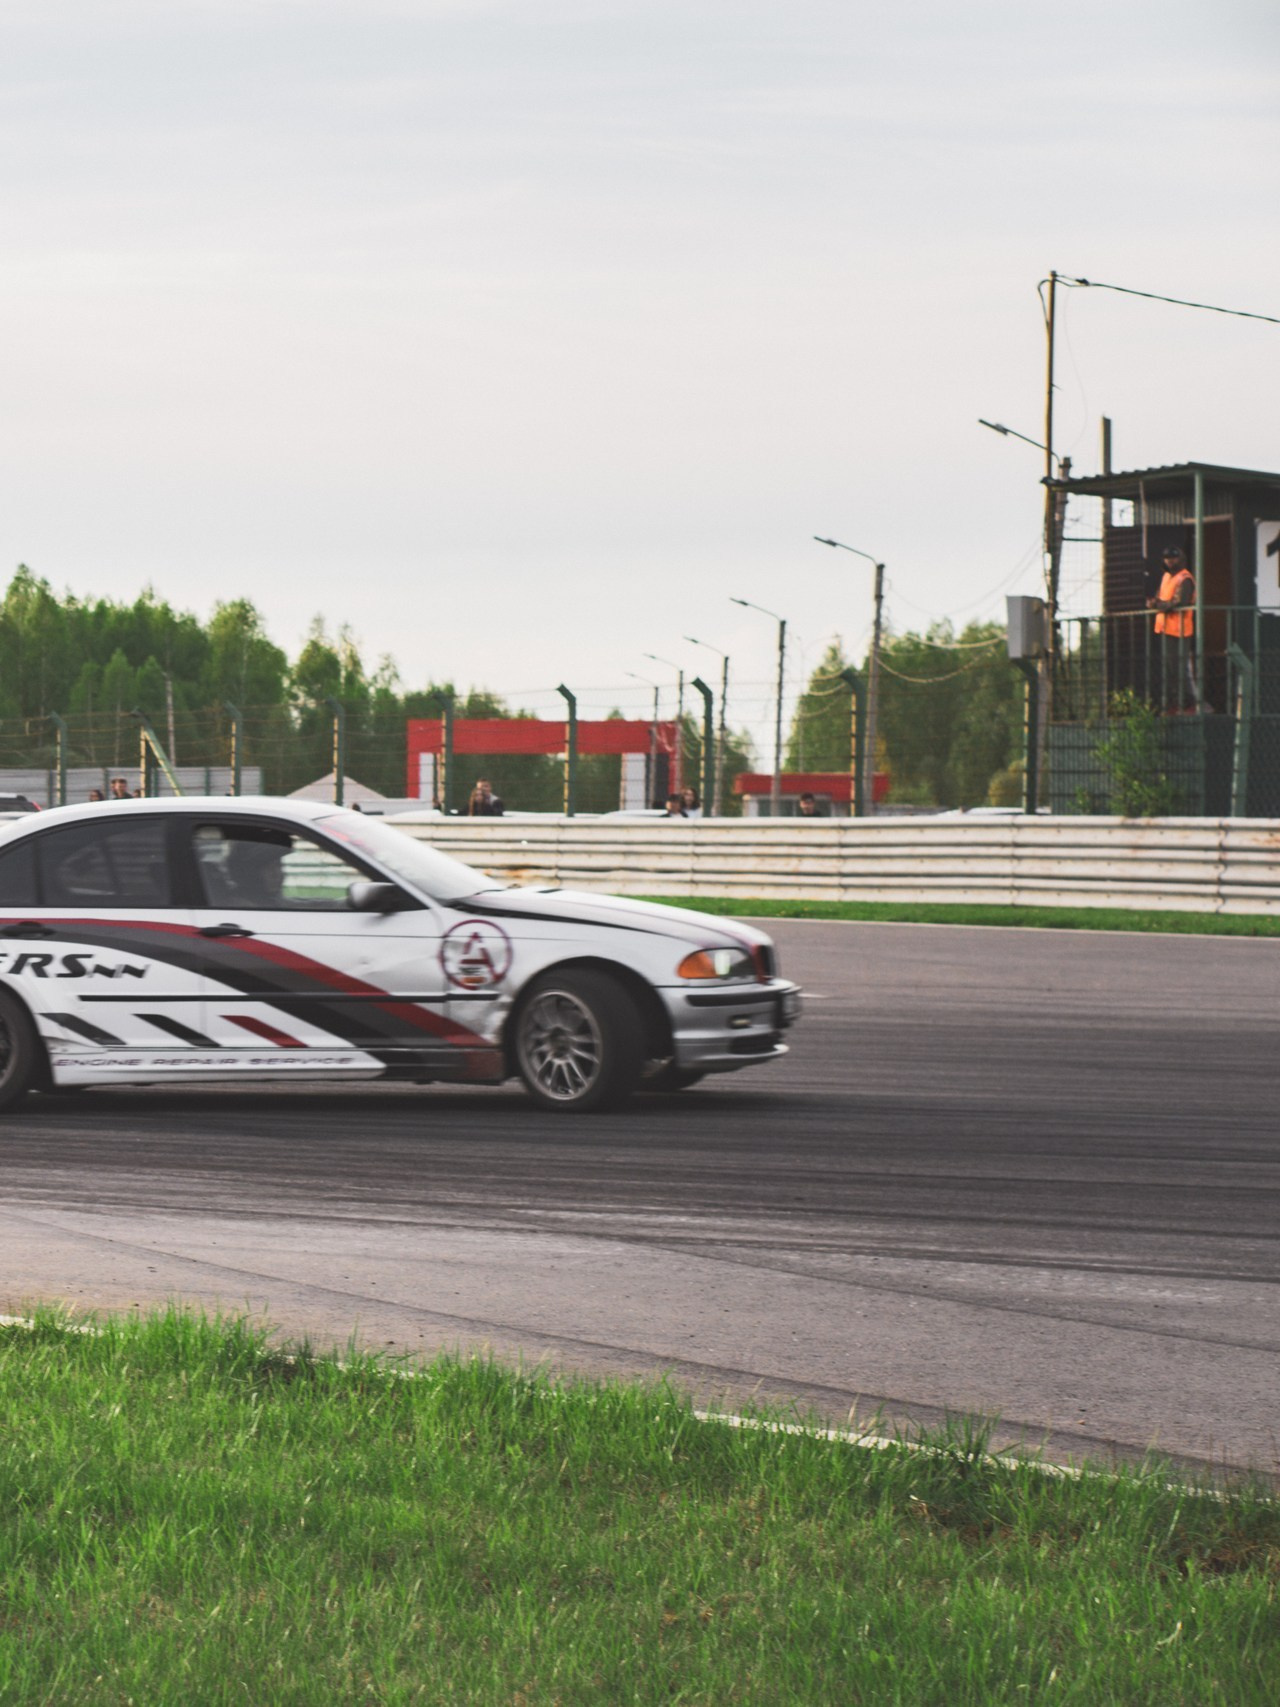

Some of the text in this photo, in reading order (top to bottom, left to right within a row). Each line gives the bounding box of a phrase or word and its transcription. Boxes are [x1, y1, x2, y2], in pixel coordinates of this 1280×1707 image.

[54, 1057, 353, 1066] ENGINE REPAIR SERVICE
